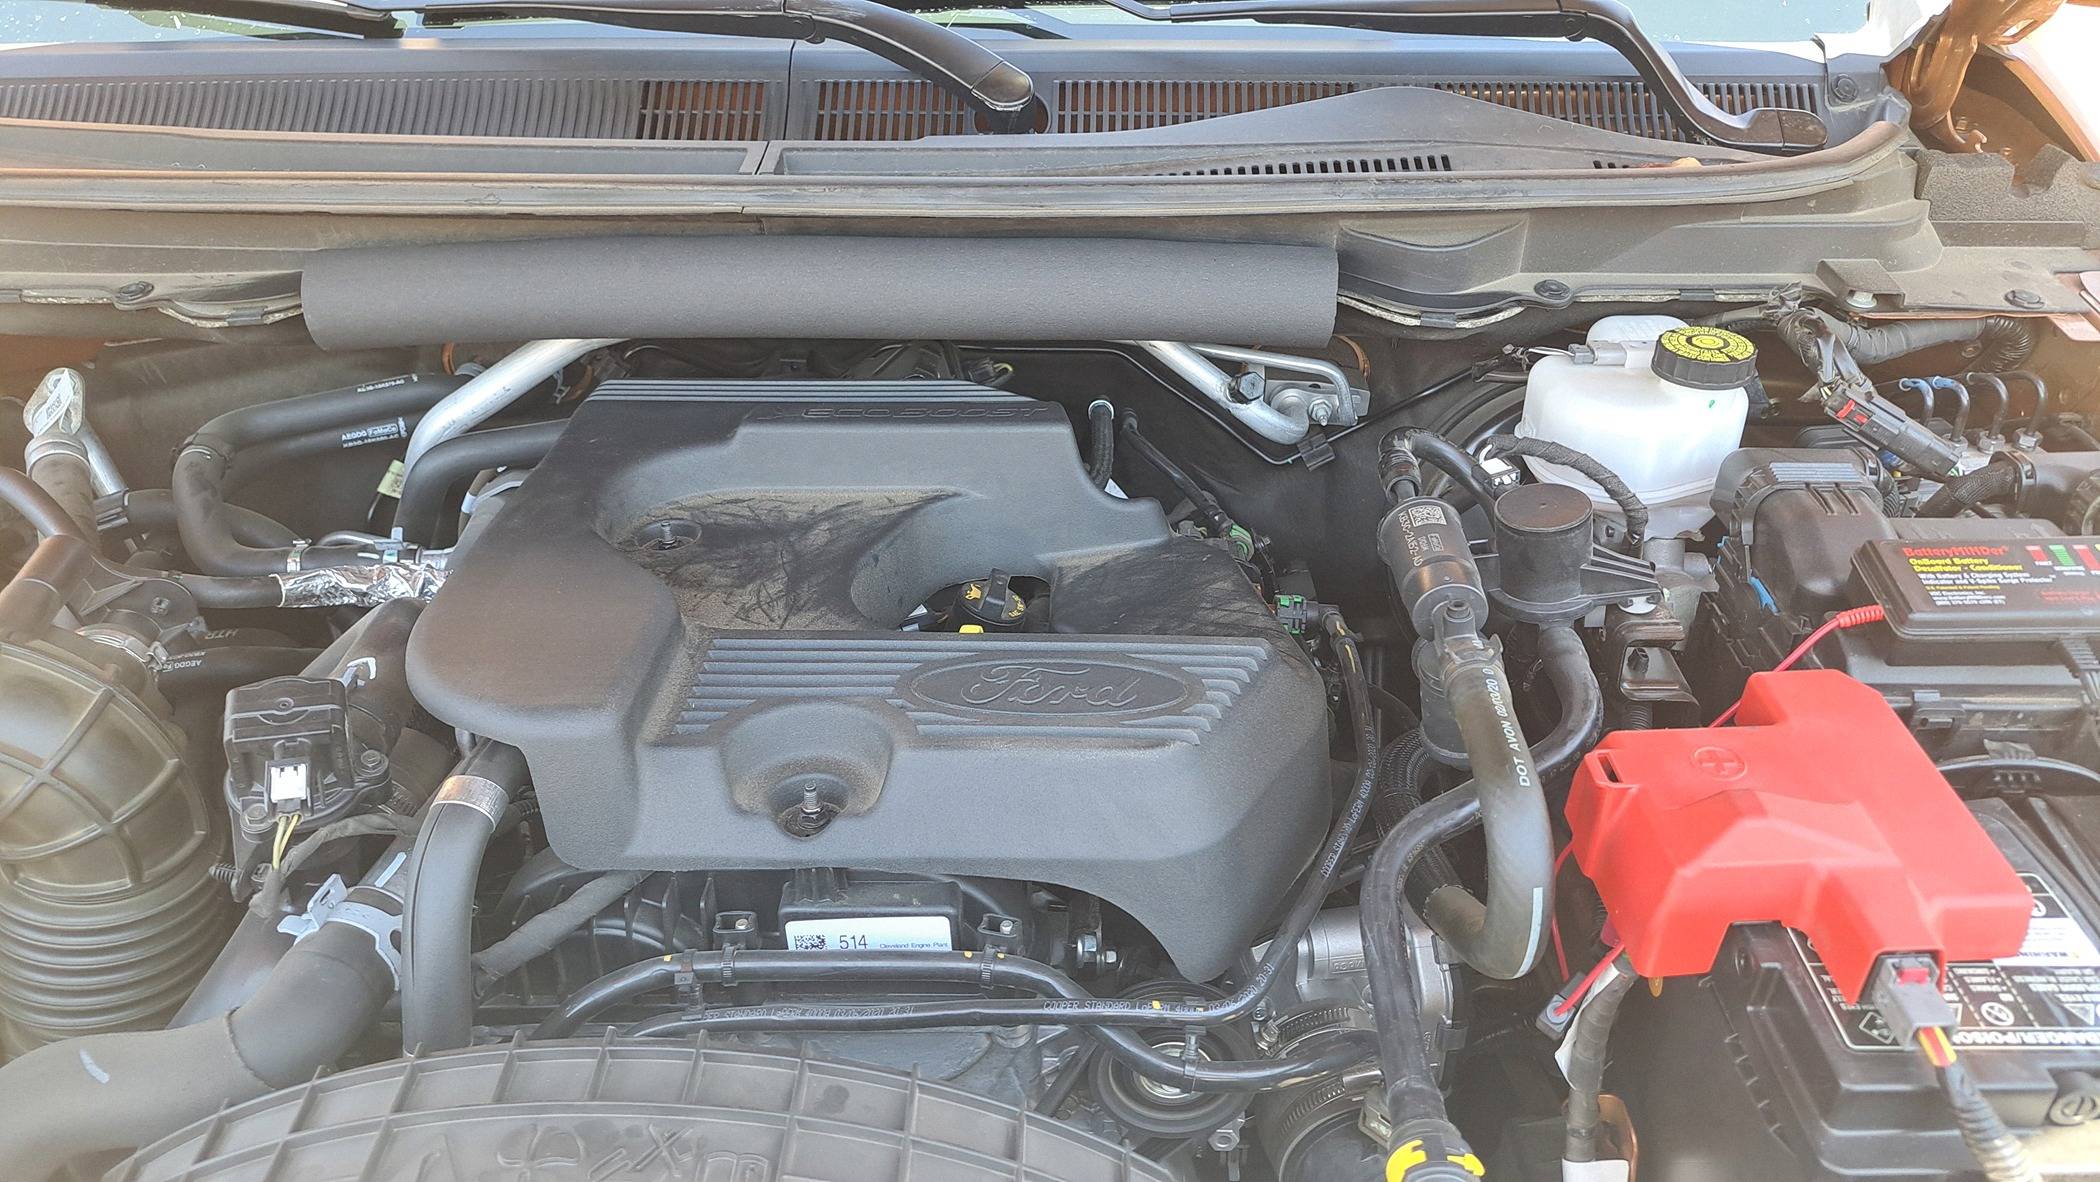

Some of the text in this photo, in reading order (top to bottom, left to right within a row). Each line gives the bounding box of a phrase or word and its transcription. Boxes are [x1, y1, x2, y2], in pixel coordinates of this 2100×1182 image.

[801, 407, 1048, 418] ECOBOOST
[961, 665, 1140, 707] Ford
[1501, 720, 1520, 752] AVON
[1513, 756, 1530, 787] DOT
[839, 935, 868, 949] 514
[1043, 1001, 1079, 1011] COOPER
[1085, 1001, 1131, 1011] STANDARD
